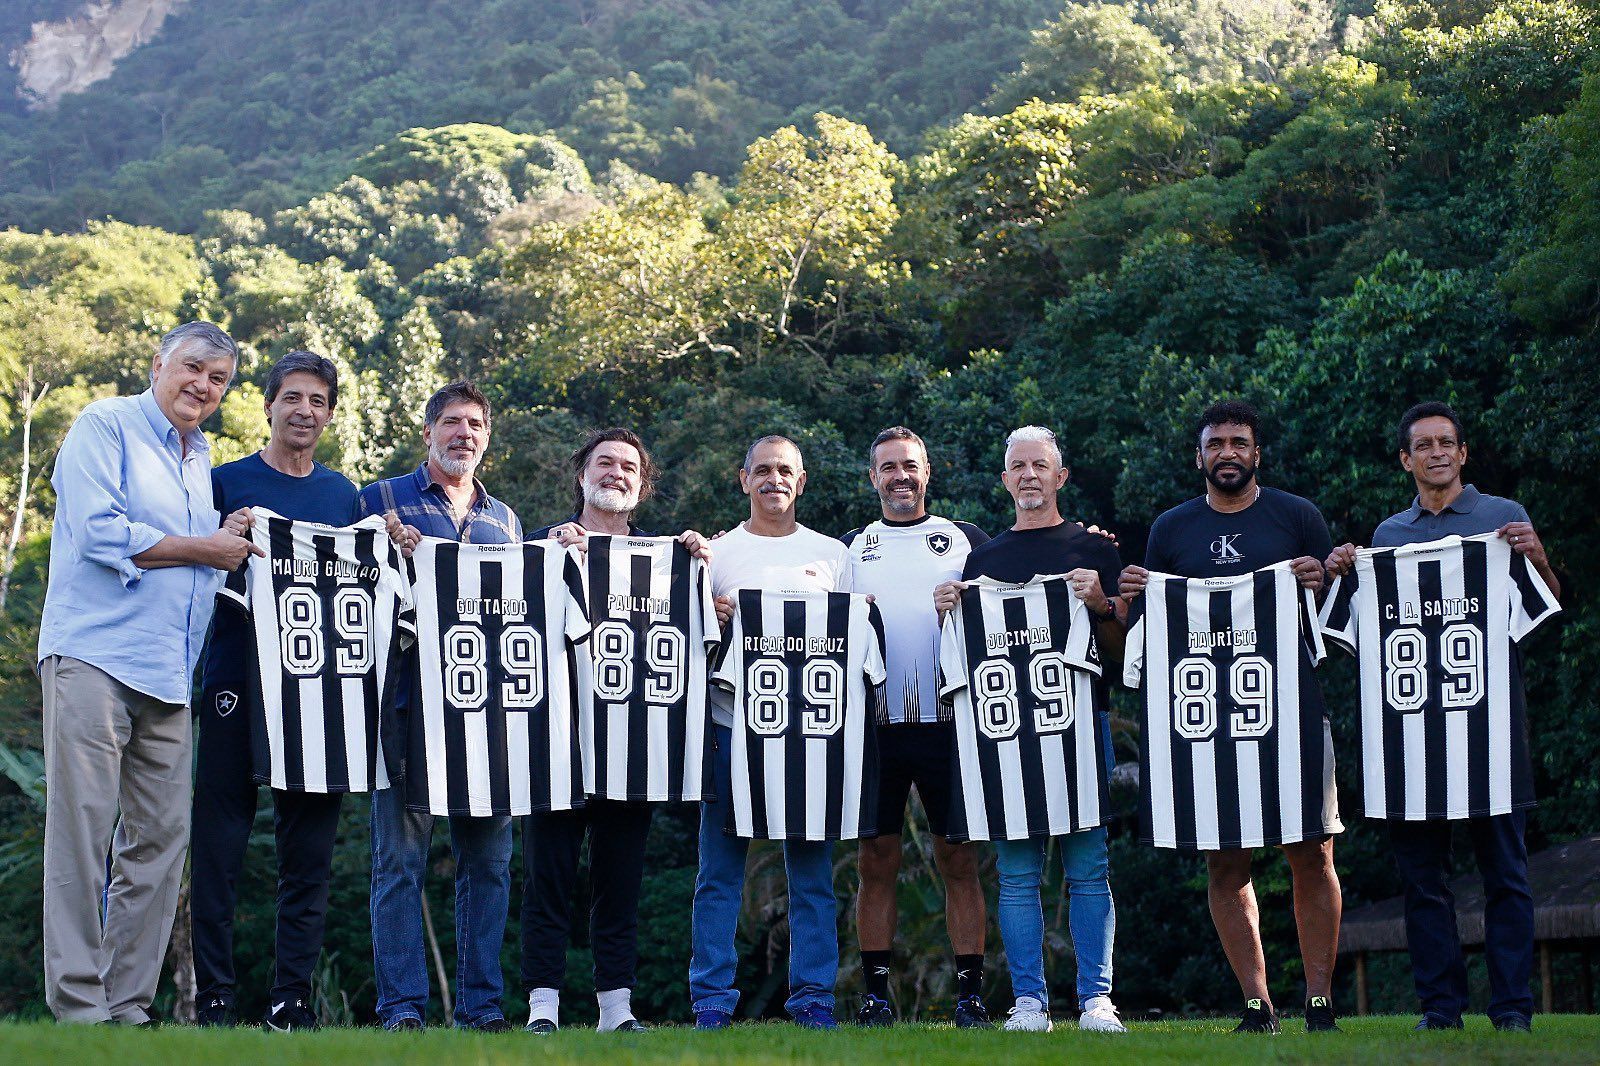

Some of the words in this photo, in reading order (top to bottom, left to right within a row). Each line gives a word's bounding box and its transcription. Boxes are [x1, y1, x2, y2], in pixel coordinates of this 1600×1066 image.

[272, 558, 319, 577] MAURO
[456, 598, 528, 616] GOTTARDO
[607, 594, 671, 615] PAULINHO
[1385, 603, 1398, 620] C.
[1405, 601, 1419, 619] A.
[1424, 597, 1479, 617] SANTOS
[278, 586, 374, 675] 89
[744, 636, 804, 652] RICARDO
[808, 637, 845, 653] CRUZ
[986, 626, 1051, 650] JOCIMAR
[1187, 626, 1258, 649] MAURÍCIO
[444, 624, 544, 710] 89
[593, 620, 686, 704] 89
[1385, 623, 1485, 711] 89
[747, 658, 844, 736] 89
[973, 651, 1076, 740] 89
[1173, 655, 1273, 739] 89
